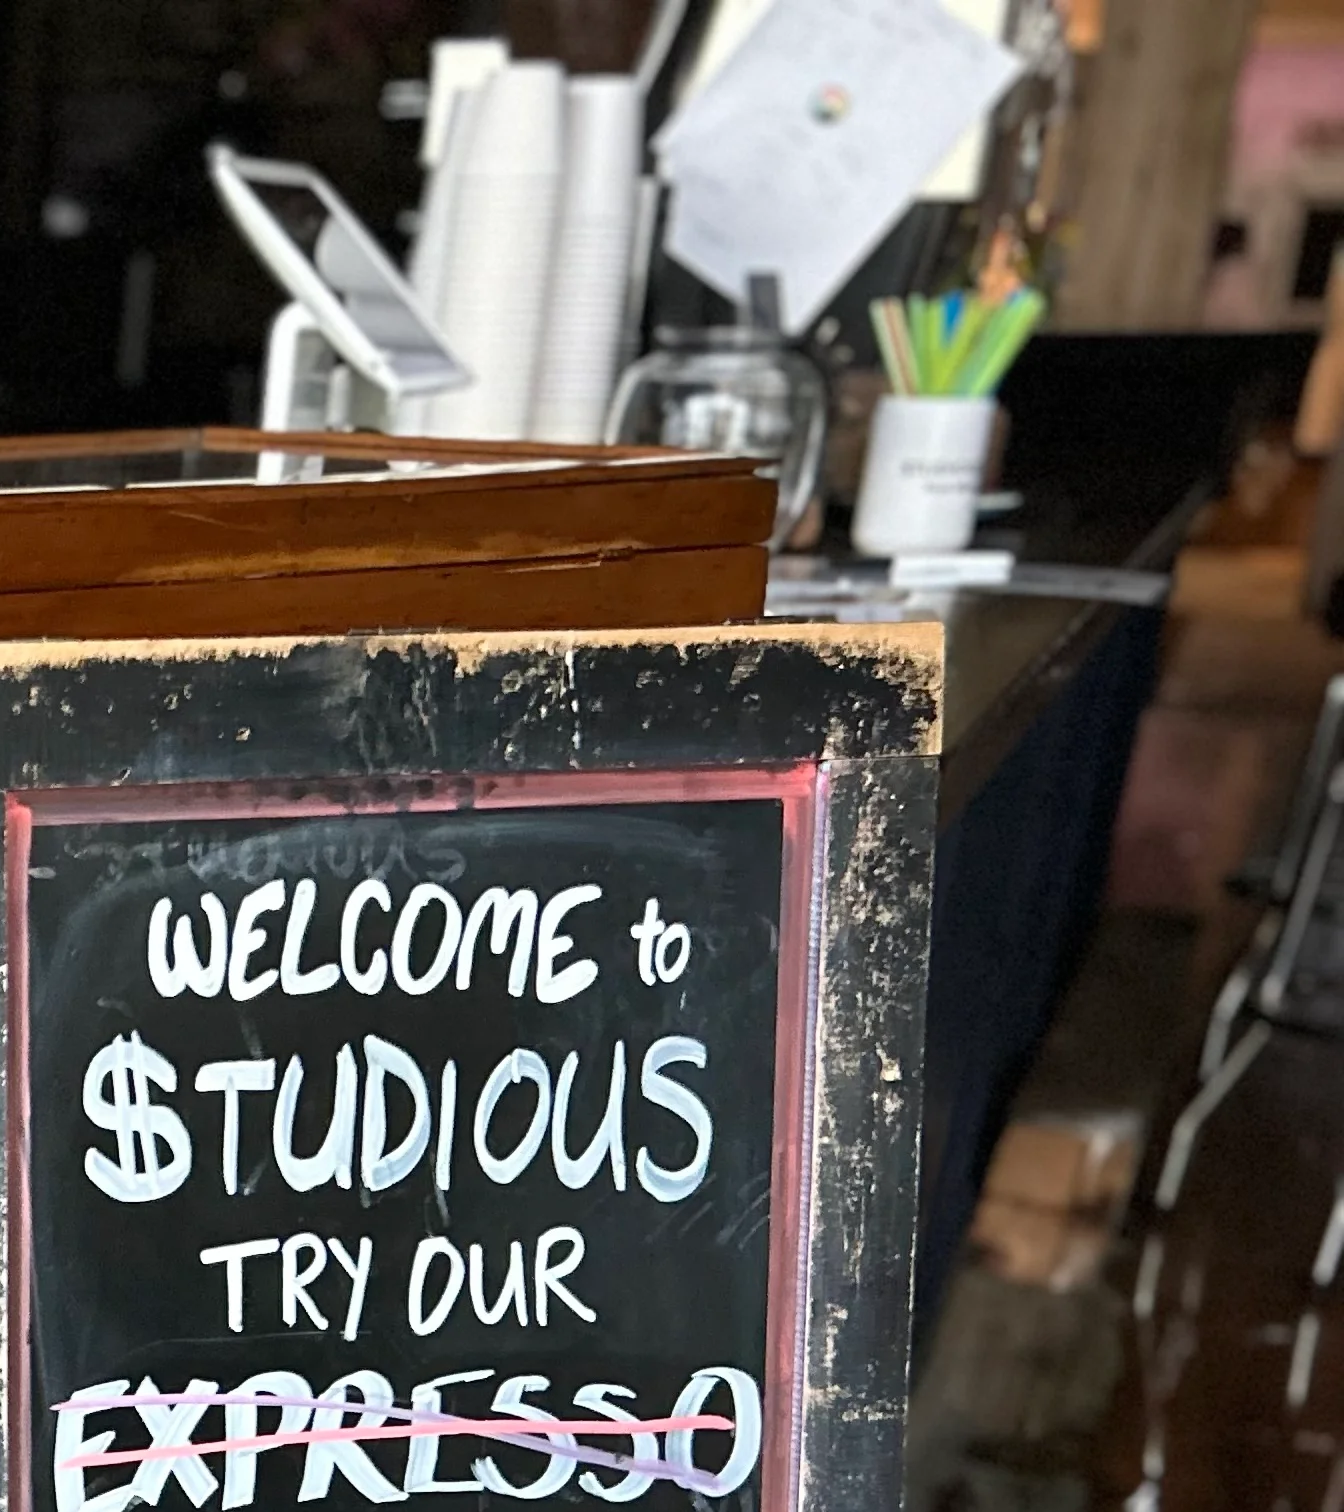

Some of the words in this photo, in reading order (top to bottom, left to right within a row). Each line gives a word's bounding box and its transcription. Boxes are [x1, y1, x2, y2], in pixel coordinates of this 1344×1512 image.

[147, 876, 605, 1003] WELCOME
[629, 896, 691, 987] to
[199, 1231, 373, 1342] TRY
[408, 1225, 598, 1337] OUR
